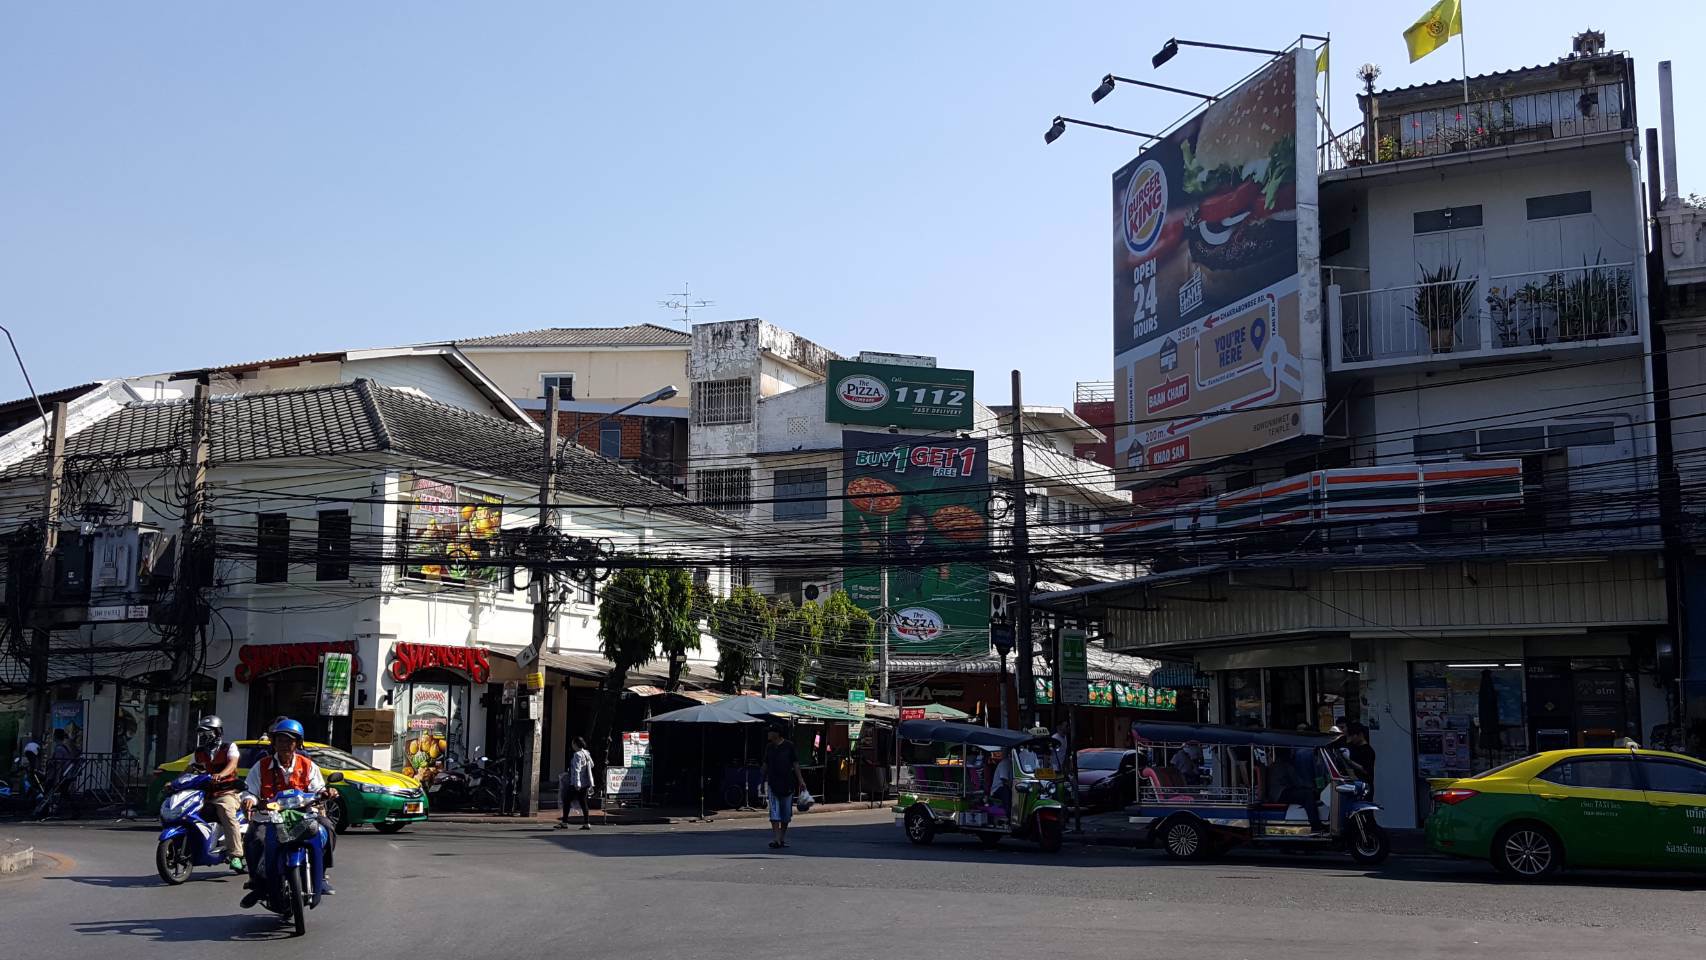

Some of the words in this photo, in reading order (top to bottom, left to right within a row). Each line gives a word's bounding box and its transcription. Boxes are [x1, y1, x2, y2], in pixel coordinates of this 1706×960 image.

[1128, 171, 1160, 218] BURGER
[1129, 186, 1162, 241] KING
[1133, 257, 1157, 284] OPEN
[1133, 276, 1158, 323] 24
[1133, 315, 1158, 340] HOURS
[1177, 328, 1190, 341] 350
[1214, 326, 1247, 353] YOU'RE
[1218, 345, 1242, 369] HERE
[847, 383, 881, 397] PIZZA
[895, 386, 966, 406] 1112
[1148, 391, 1166, 409] BAAN
[1167, 382, 1187, 402] CHART
[1145, 430, 1157, 443] 200
[856, 450, 893, 467] BUY
[911, 446, 957, 468] GET
[959, 447, 976, 477] 1
[1153, 448, 1170, 465] KHAO
[1171, 443, 1185, 460] SAN
[933, 467, 957, 477] FREE
